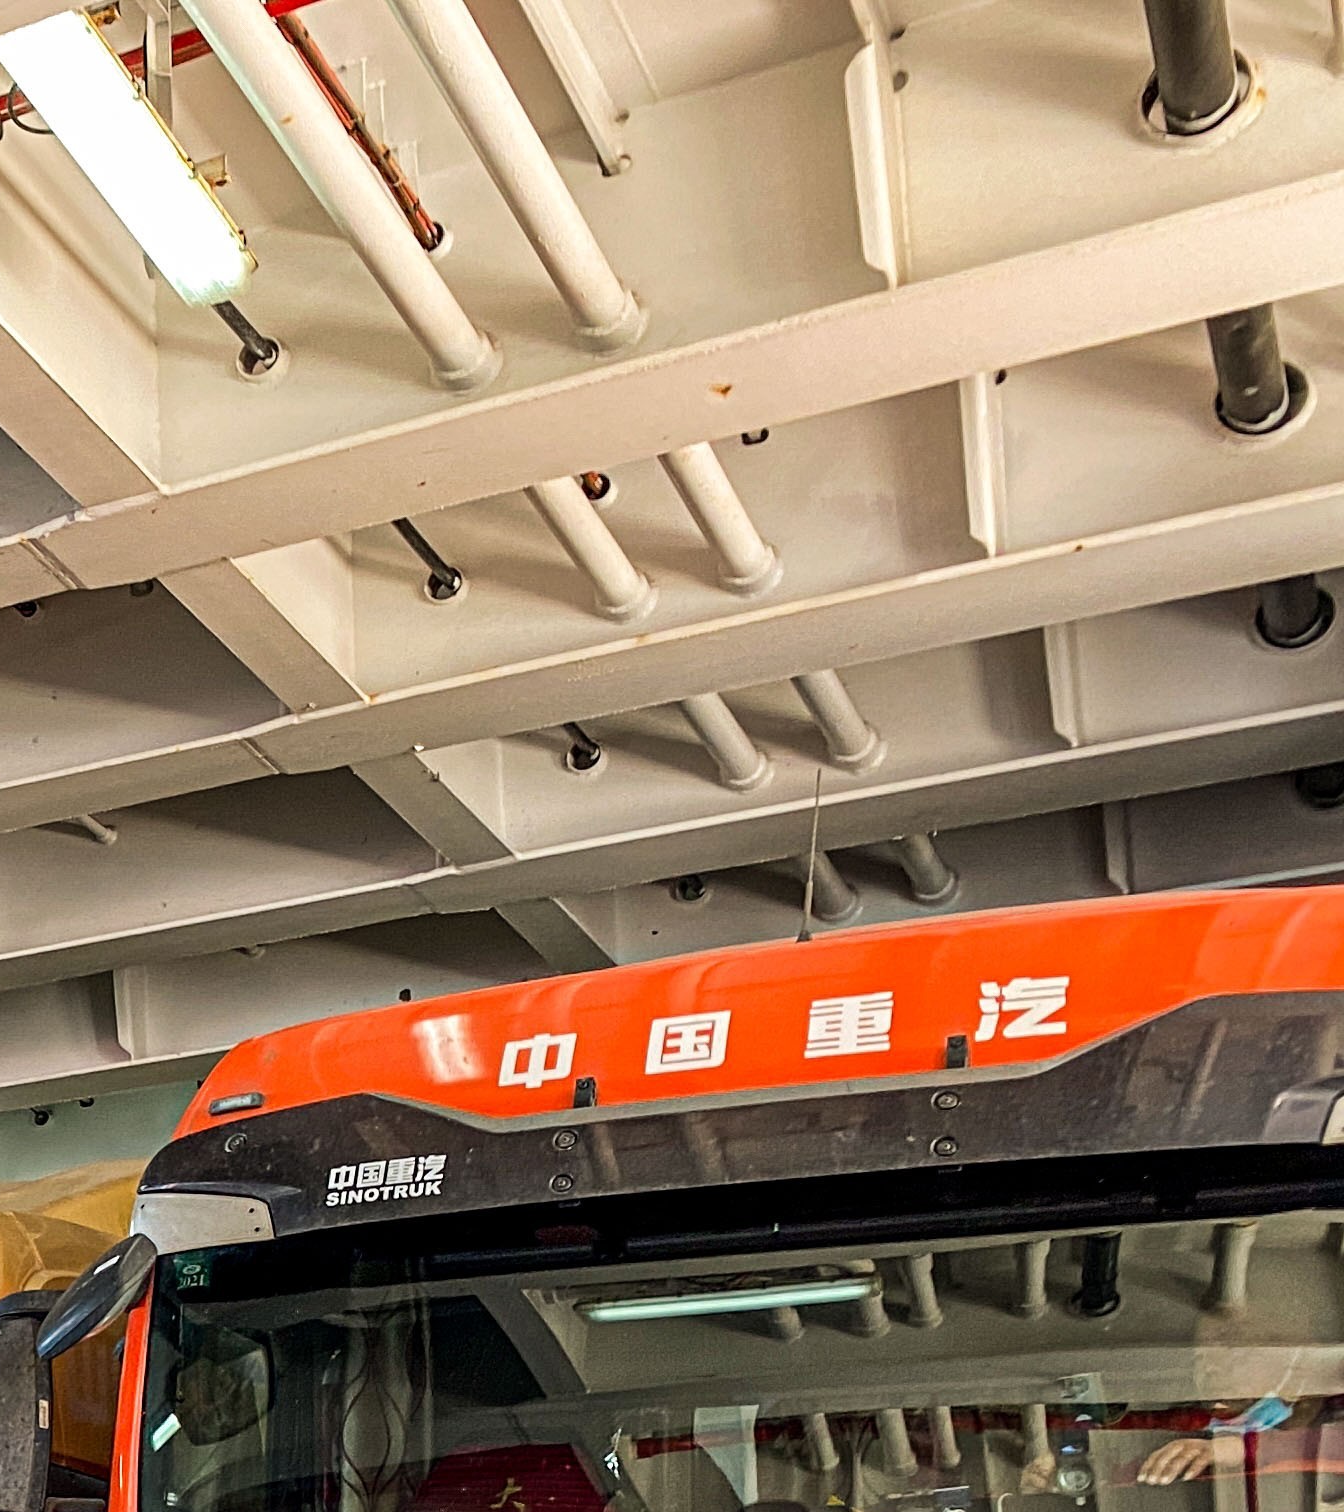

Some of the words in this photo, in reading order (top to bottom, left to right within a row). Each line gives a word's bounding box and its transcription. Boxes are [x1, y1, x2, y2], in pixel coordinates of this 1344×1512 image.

[498, 977, 1069, 1088] 中国重汽
[328, 1155, 447, 1190] 中国重汽
[326, 1181, 442, 1207] SINOTRUK
